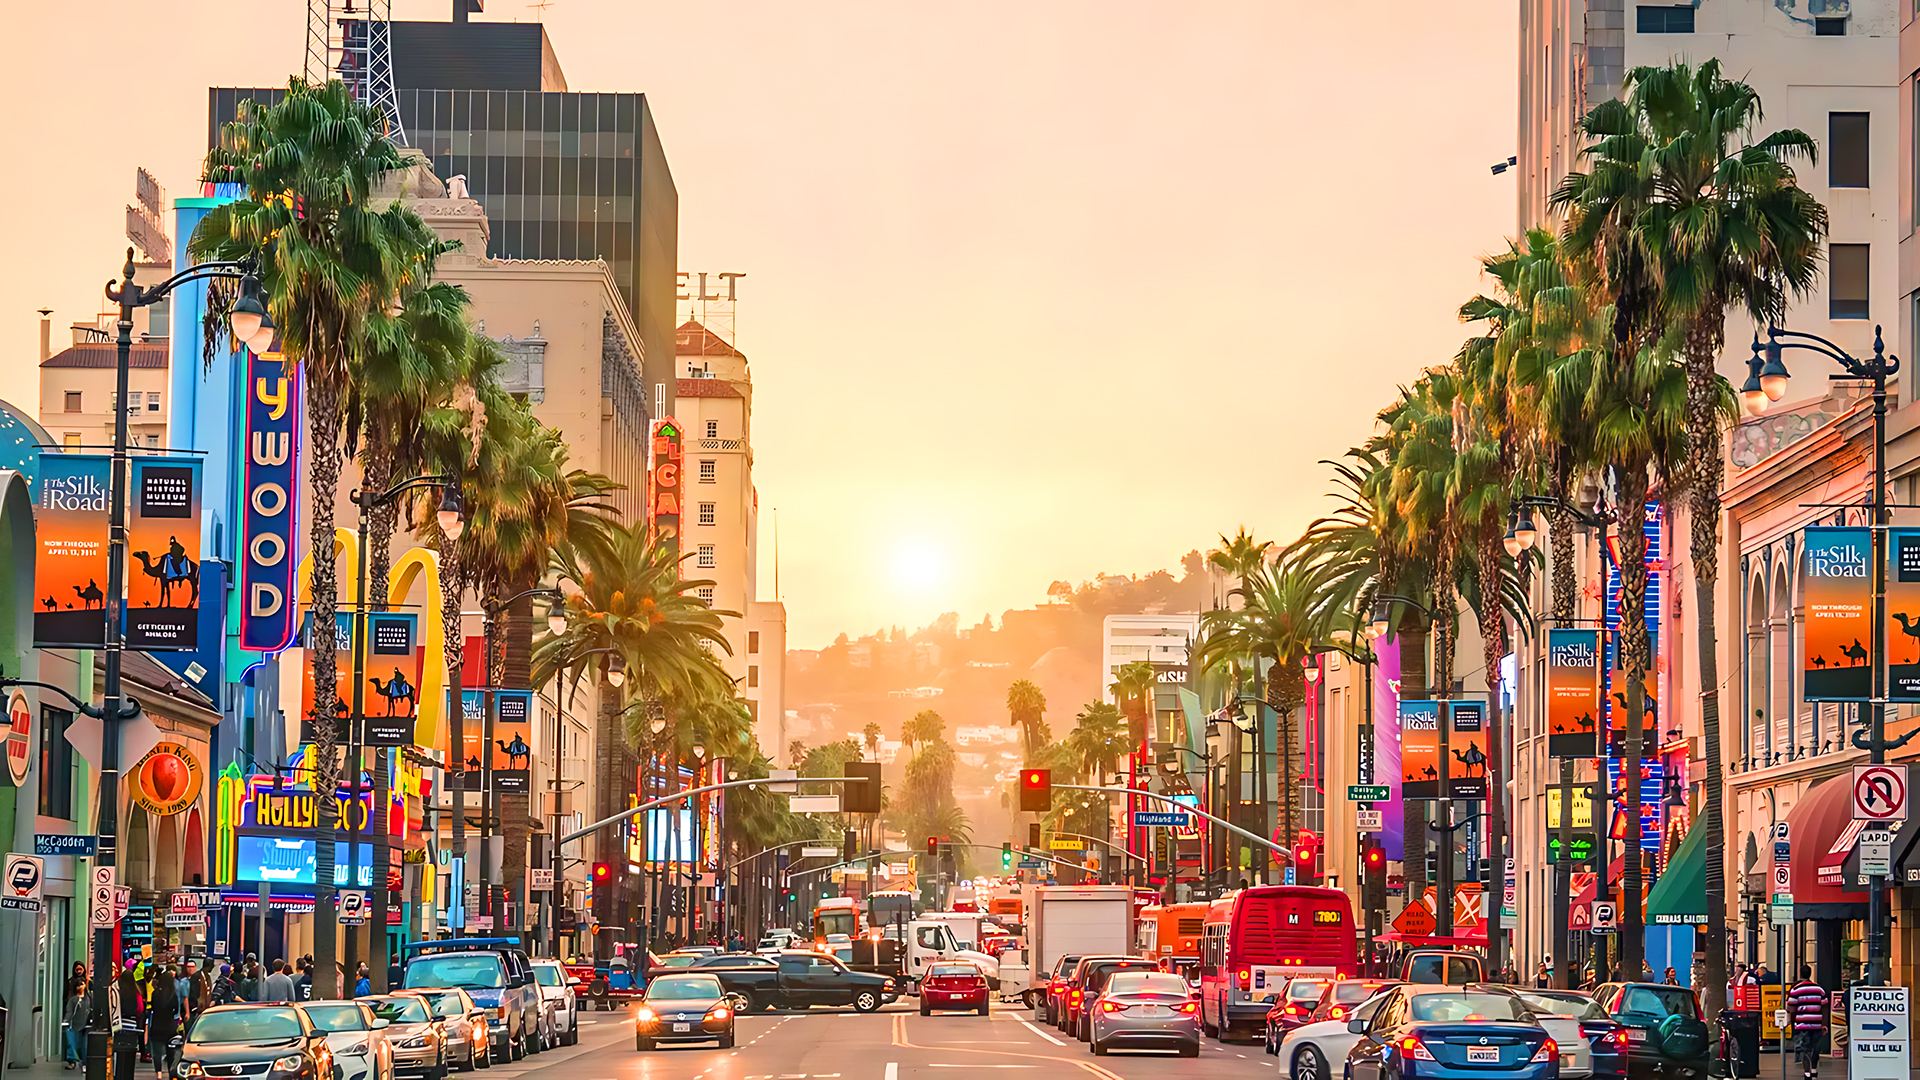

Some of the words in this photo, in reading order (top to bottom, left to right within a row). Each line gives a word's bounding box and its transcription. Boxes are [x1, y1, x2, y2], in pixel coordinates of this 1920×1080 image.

[66, 475, 102, 496] Silk
[50, 488, 106, 512] Road
[1829, 544, 1862, 564] Silk
[1816, 556, 1866, 578] Road
[1567, 643, 1590, 657] Silk
[1557, 652, 1594, 667] Road
[168, 800, 187, 813] 1989
[37, 835, 86, 848] McCadden
[1861, 833, 1889, 842] LAPD
[174, 895, 197, 907] ATM
[304, 987, 311, 999] 5
[1854, 992, 1904, 1001] PUBLIC
[1854, 1003, 1905, 1012] PARKING
